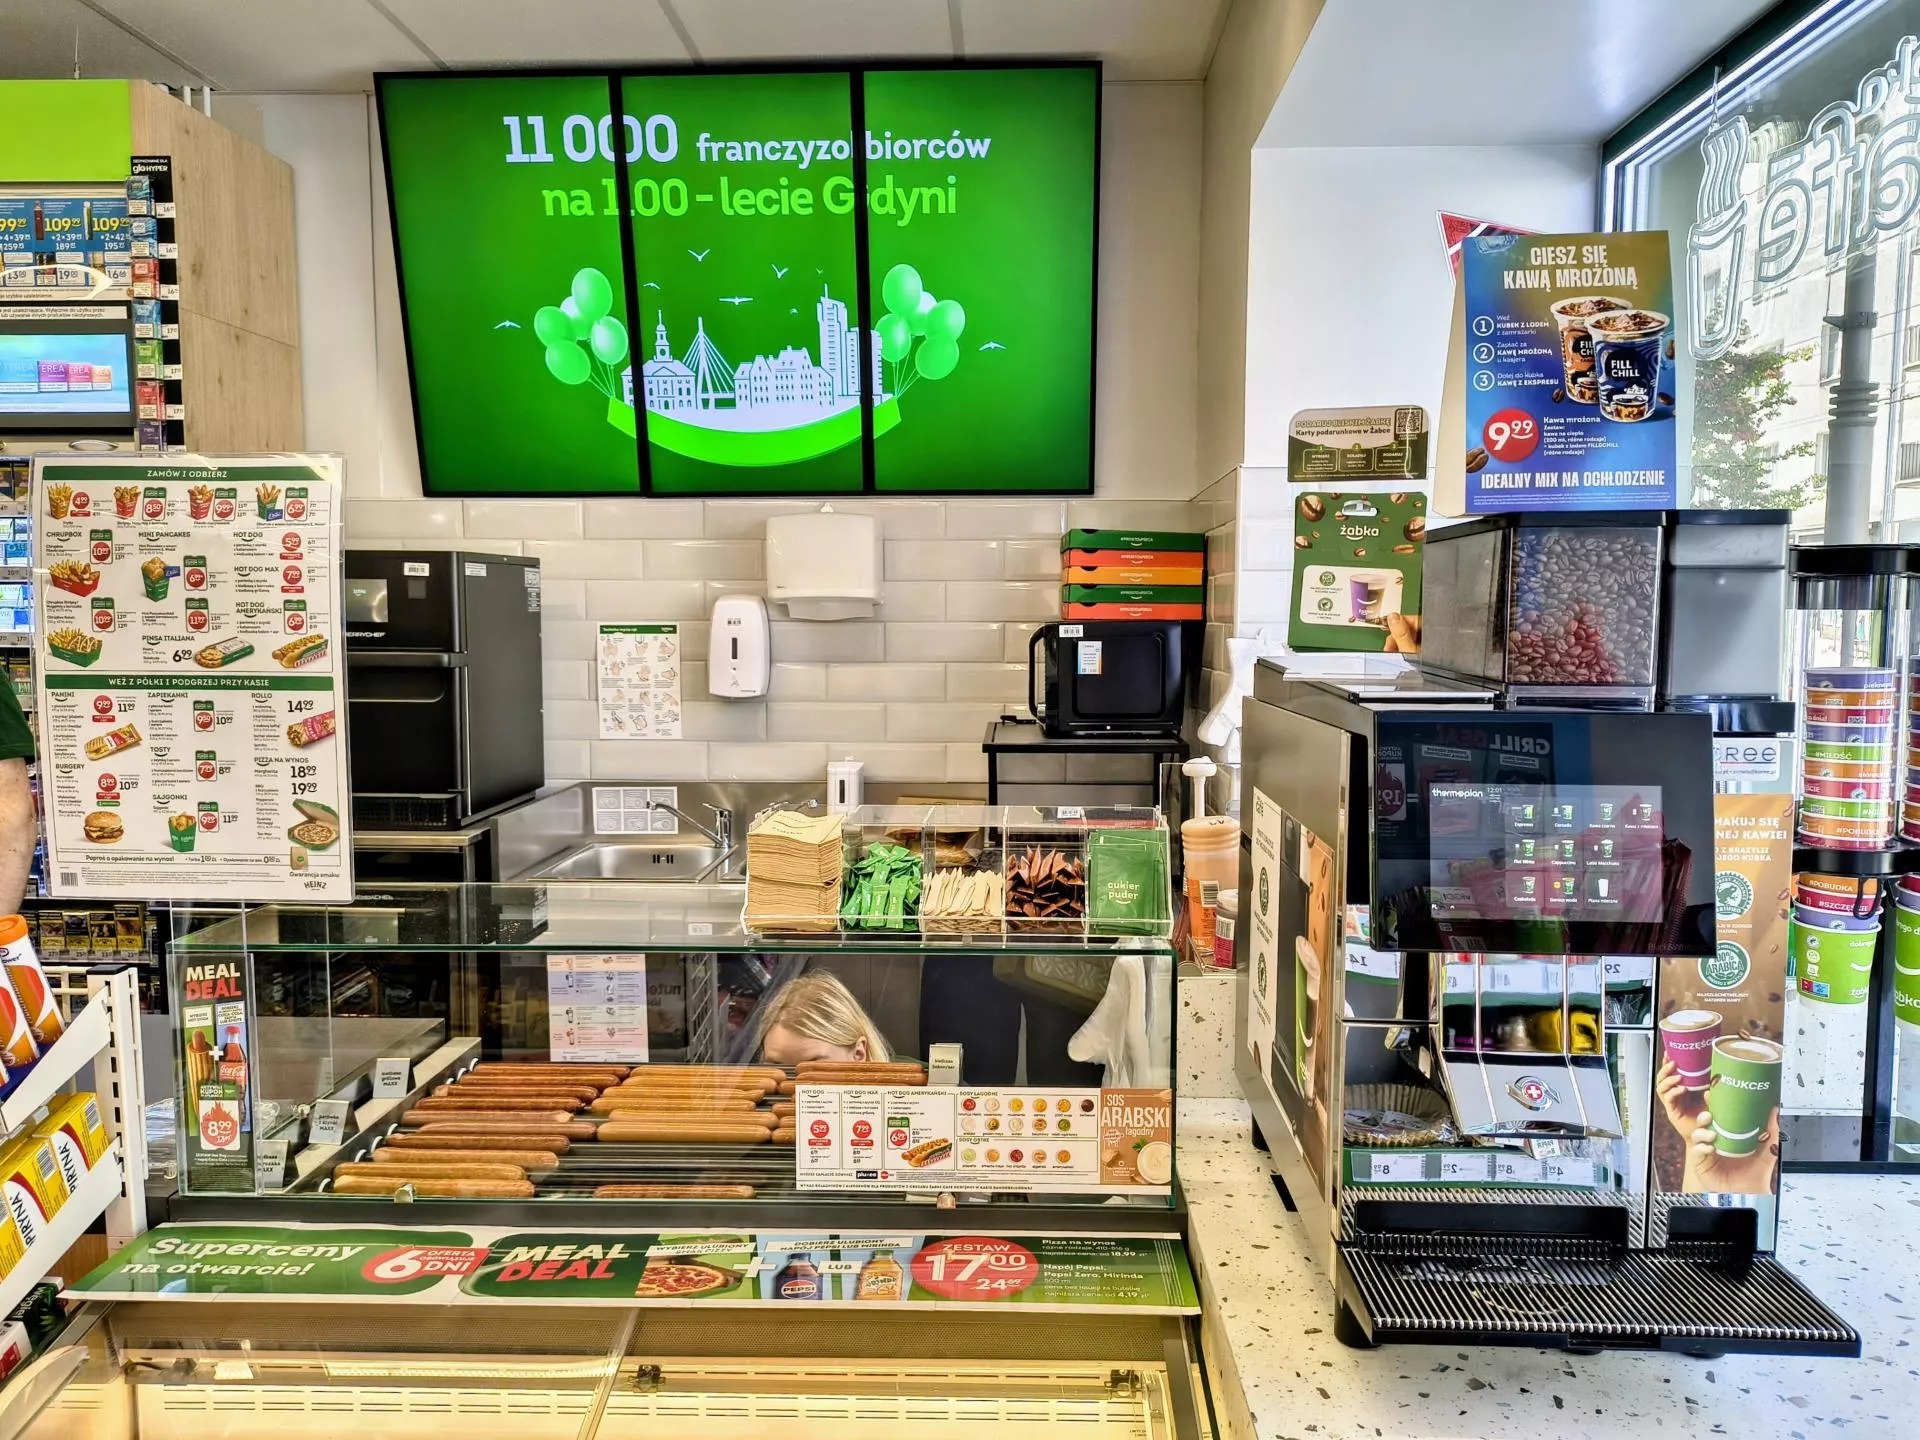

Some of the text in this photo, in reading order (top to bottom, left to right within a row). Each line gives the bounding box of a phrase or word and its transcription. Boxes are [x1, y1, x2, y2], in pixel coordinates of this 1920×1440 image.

[503, 116, 554, 163] 11
[696, 130, 991, 169] franczyzobiorców
[542, 189, 594, 216] na
[822, 175, 957, 227] Gdyni
[1530, 245, 1608, 267] CIESZ SIĘ
[1504, 264, 1638, 292] KAWĄ MROŻONĄ
[1480, 321, 1487, 331] 1
[1497, 341, 1520, 349] Zapłać
[1480, 348, 1488, 358] 2
[1497, 348, 1553, 358] KAWĘ MROŻONĄ
[41, 364, 90, 374] EREA EREA
[1611, 360, 1632, 369] FILL
[1611, 369, 1640, 377] CHILL
[1480, 375, 1488, 386] 3
[1524, 378, 1559, 386] EKSPRESU
[1567, 415, 1600, 423] mrożona
[1295, 429, 1315, 437] Karty
[1316, 429, 1362, 437] podarunkowe
[147, 469, 228, 478] ZAMÓW ODBIERZ
[1481, 470, 1665, 489] IDEALNY MIX NA OCHŁODZENIE
[1340, 525, 1379, 540] żabka
[136, 677, 164, 686] PÓŁKI
[173, 679, 217, 687] PODGRZEJ
[1816, 750, 1853, 760] #MIŁOŚĆ
[1432, 788, 1484, 799] thermoplan
[1758, 817, 1780, 829] SIĘ
[1715, 830, 1739, 840] NEJ
[1742, 854, 1772, 862] KUBKA
[289, 871, 320, 879] Gwarancja
[304, 880, 328, 890] HEINZ
[1108, 879, 1140, 891] cukier
[1809, 879, 1854, 893] #POBUDKA
[1108, 890, 1139, 901] puder
[1818, 899, 1870, 914] #SZCZĘŚIE
[186, 963, 240, 981] MEAL
[1706, 959, 1744, 975] ARABICA
[186, 977, 242, 1000] DEAL
[1669, 1037, 1714, 1051] #SZCZĘŚC
[1721, 1073, 1771, 1090] #SUKCES
[1106, 1095, 1124, 1106] SOS
[1101, 1107, 1170, 1128] ARABSKI
[1125, 1127, 1155, 1138] łagodny
[59, 1142, 78, 1194] PIRYNA
[9, 1191, 37, 1247] PIRYNA
[147, 1238, 366, 1262] Superceny
[502, 1244, 631, 1261] MEAL
[942, 1243, 1011, 1251] ZESTAW
[120, 1262, 317, 1275] na otwarcie!
[373, 1249, 425, 1279] 6
[423, 1262, 469, 1272] DNI
[1043, 1263, 1073, 1272] Napój
[496, 1259, 616, 1282] DEAL
[1043, 1271, 1073, 1280] Pepsi
[782, 1285, 816, 1293] PEPSI
